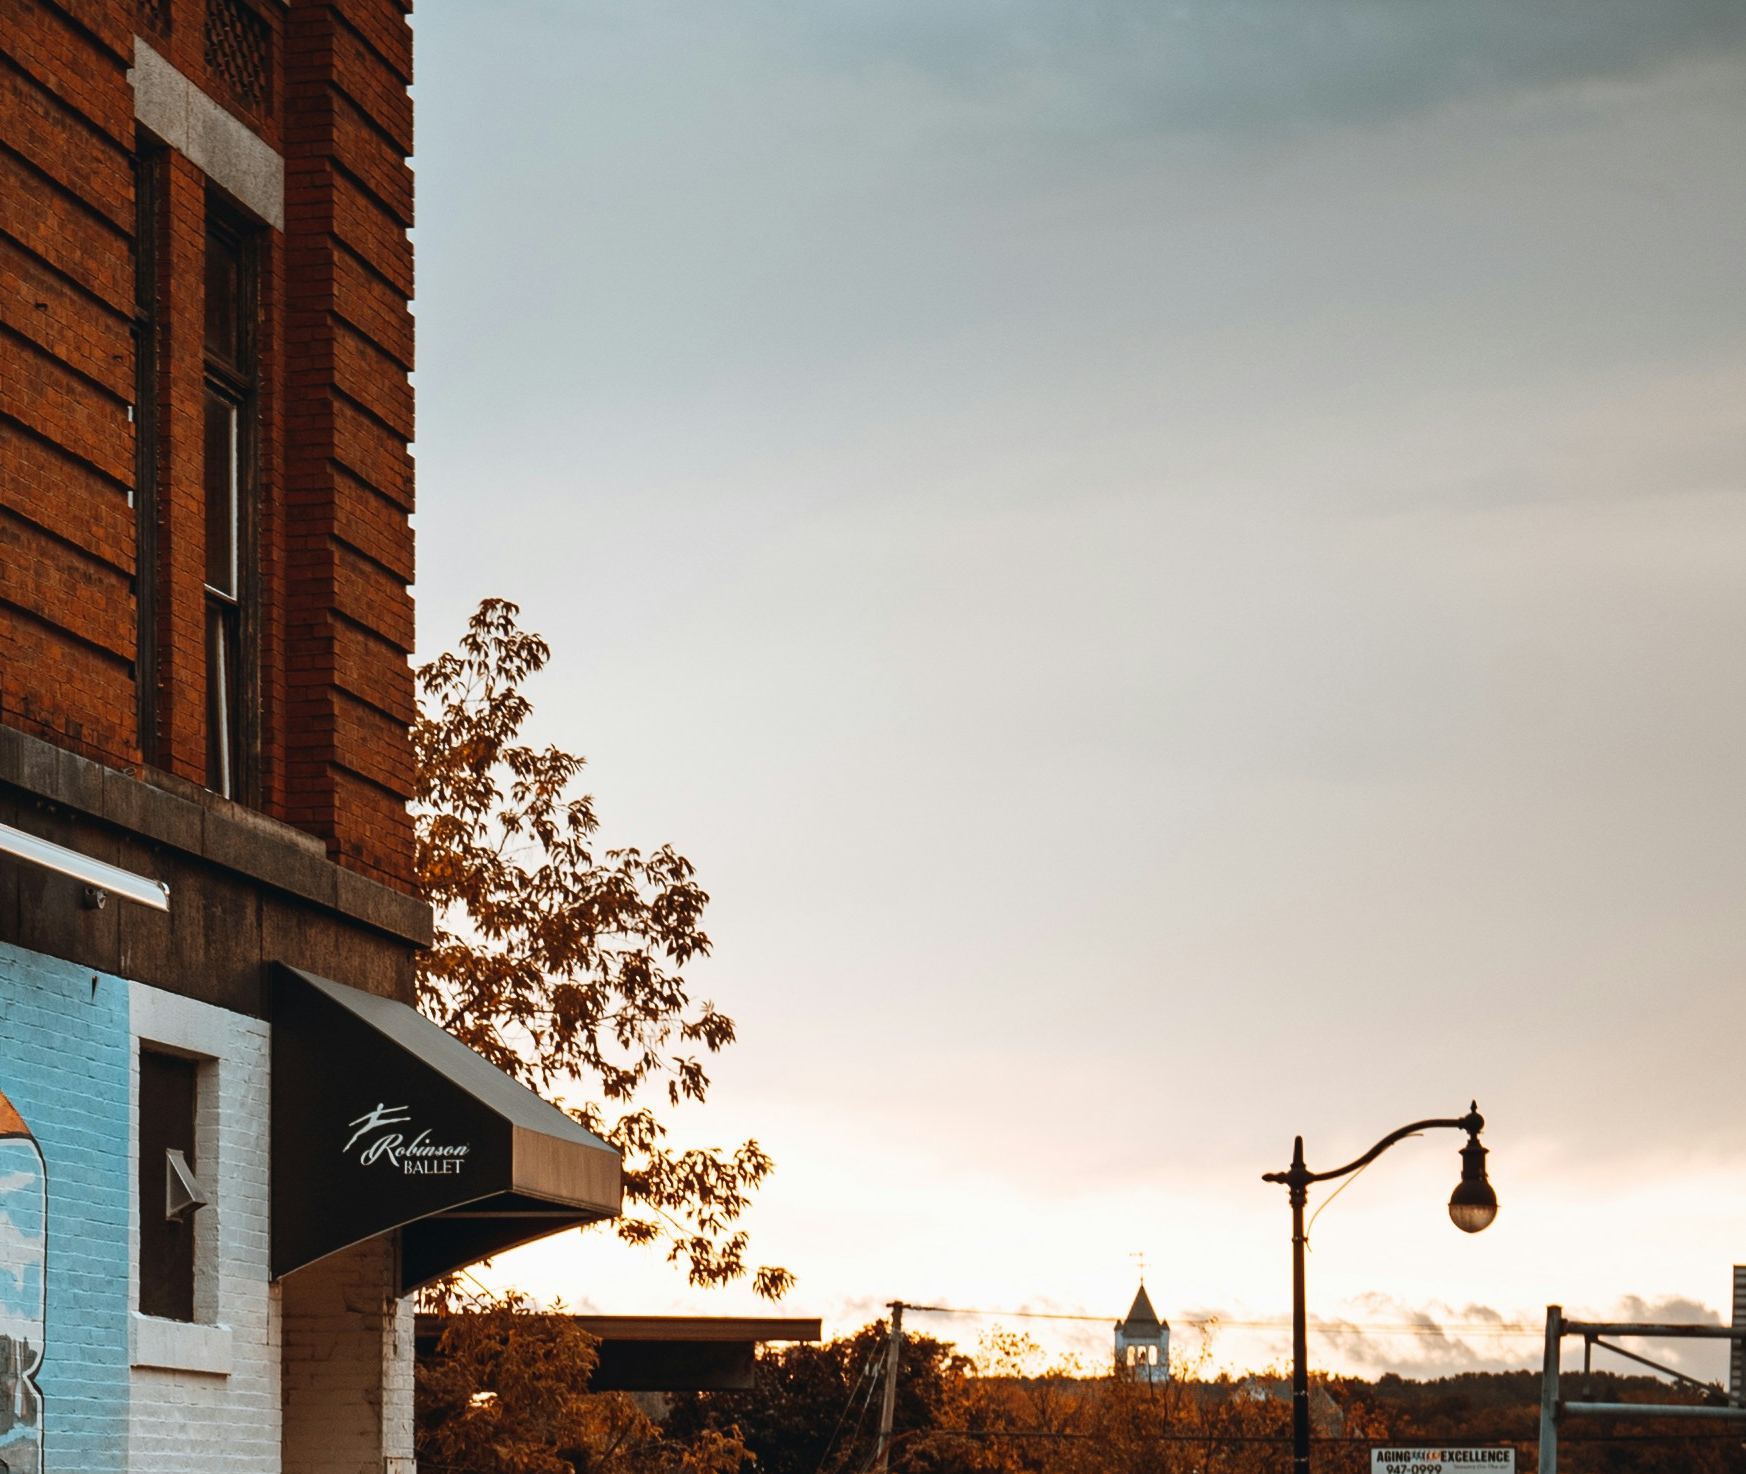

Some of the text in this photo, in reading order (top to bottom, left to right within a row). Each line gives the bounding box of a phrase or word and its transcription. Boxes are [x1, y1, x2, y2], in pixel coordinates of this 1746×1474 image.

[360, 1128, 469, 1167] Robinson
[404, 1159, 465, 1175] BALLET
[1376, 1451, 1510, 1463] AGING EXCELLENCE
[1386, 1464, 1442, 1474] 947-0999
